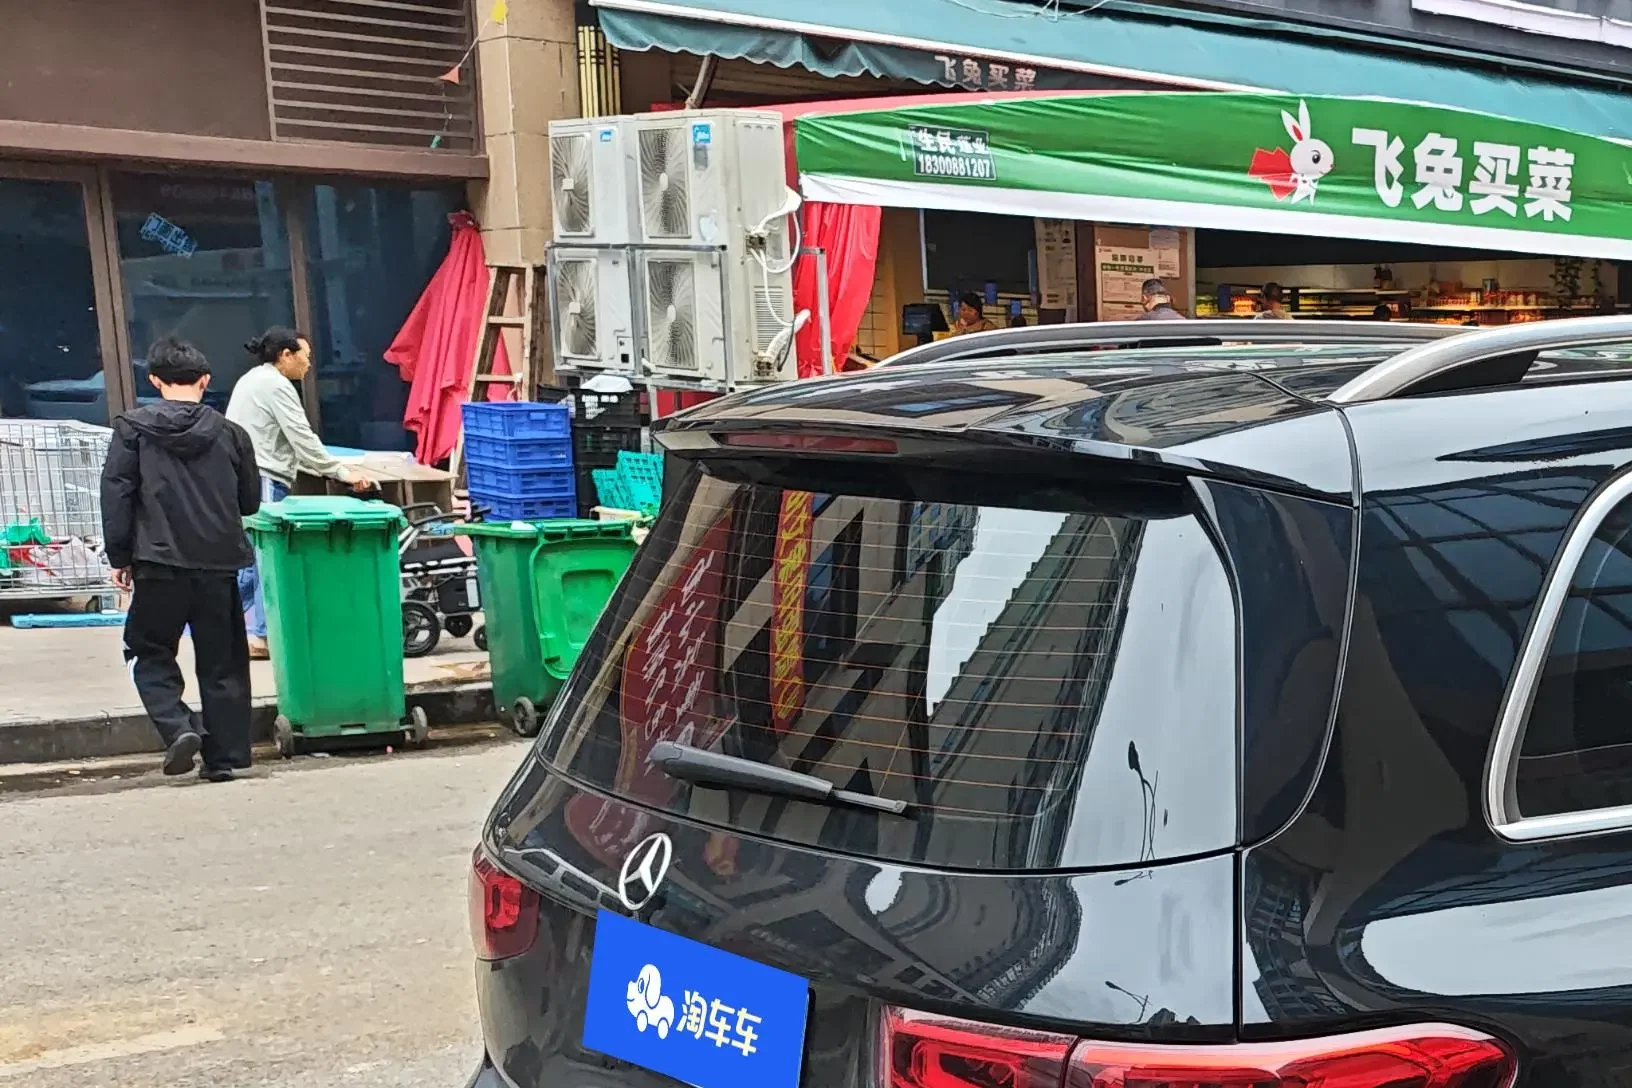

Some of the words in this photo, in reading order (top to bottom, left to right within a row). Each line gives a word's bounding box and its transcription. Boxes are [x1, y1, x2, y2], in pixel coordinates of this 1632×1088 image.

[918, 154, 990, 178] 18300881207
[1351, 127, 1575, 222] 飞兔买菜
